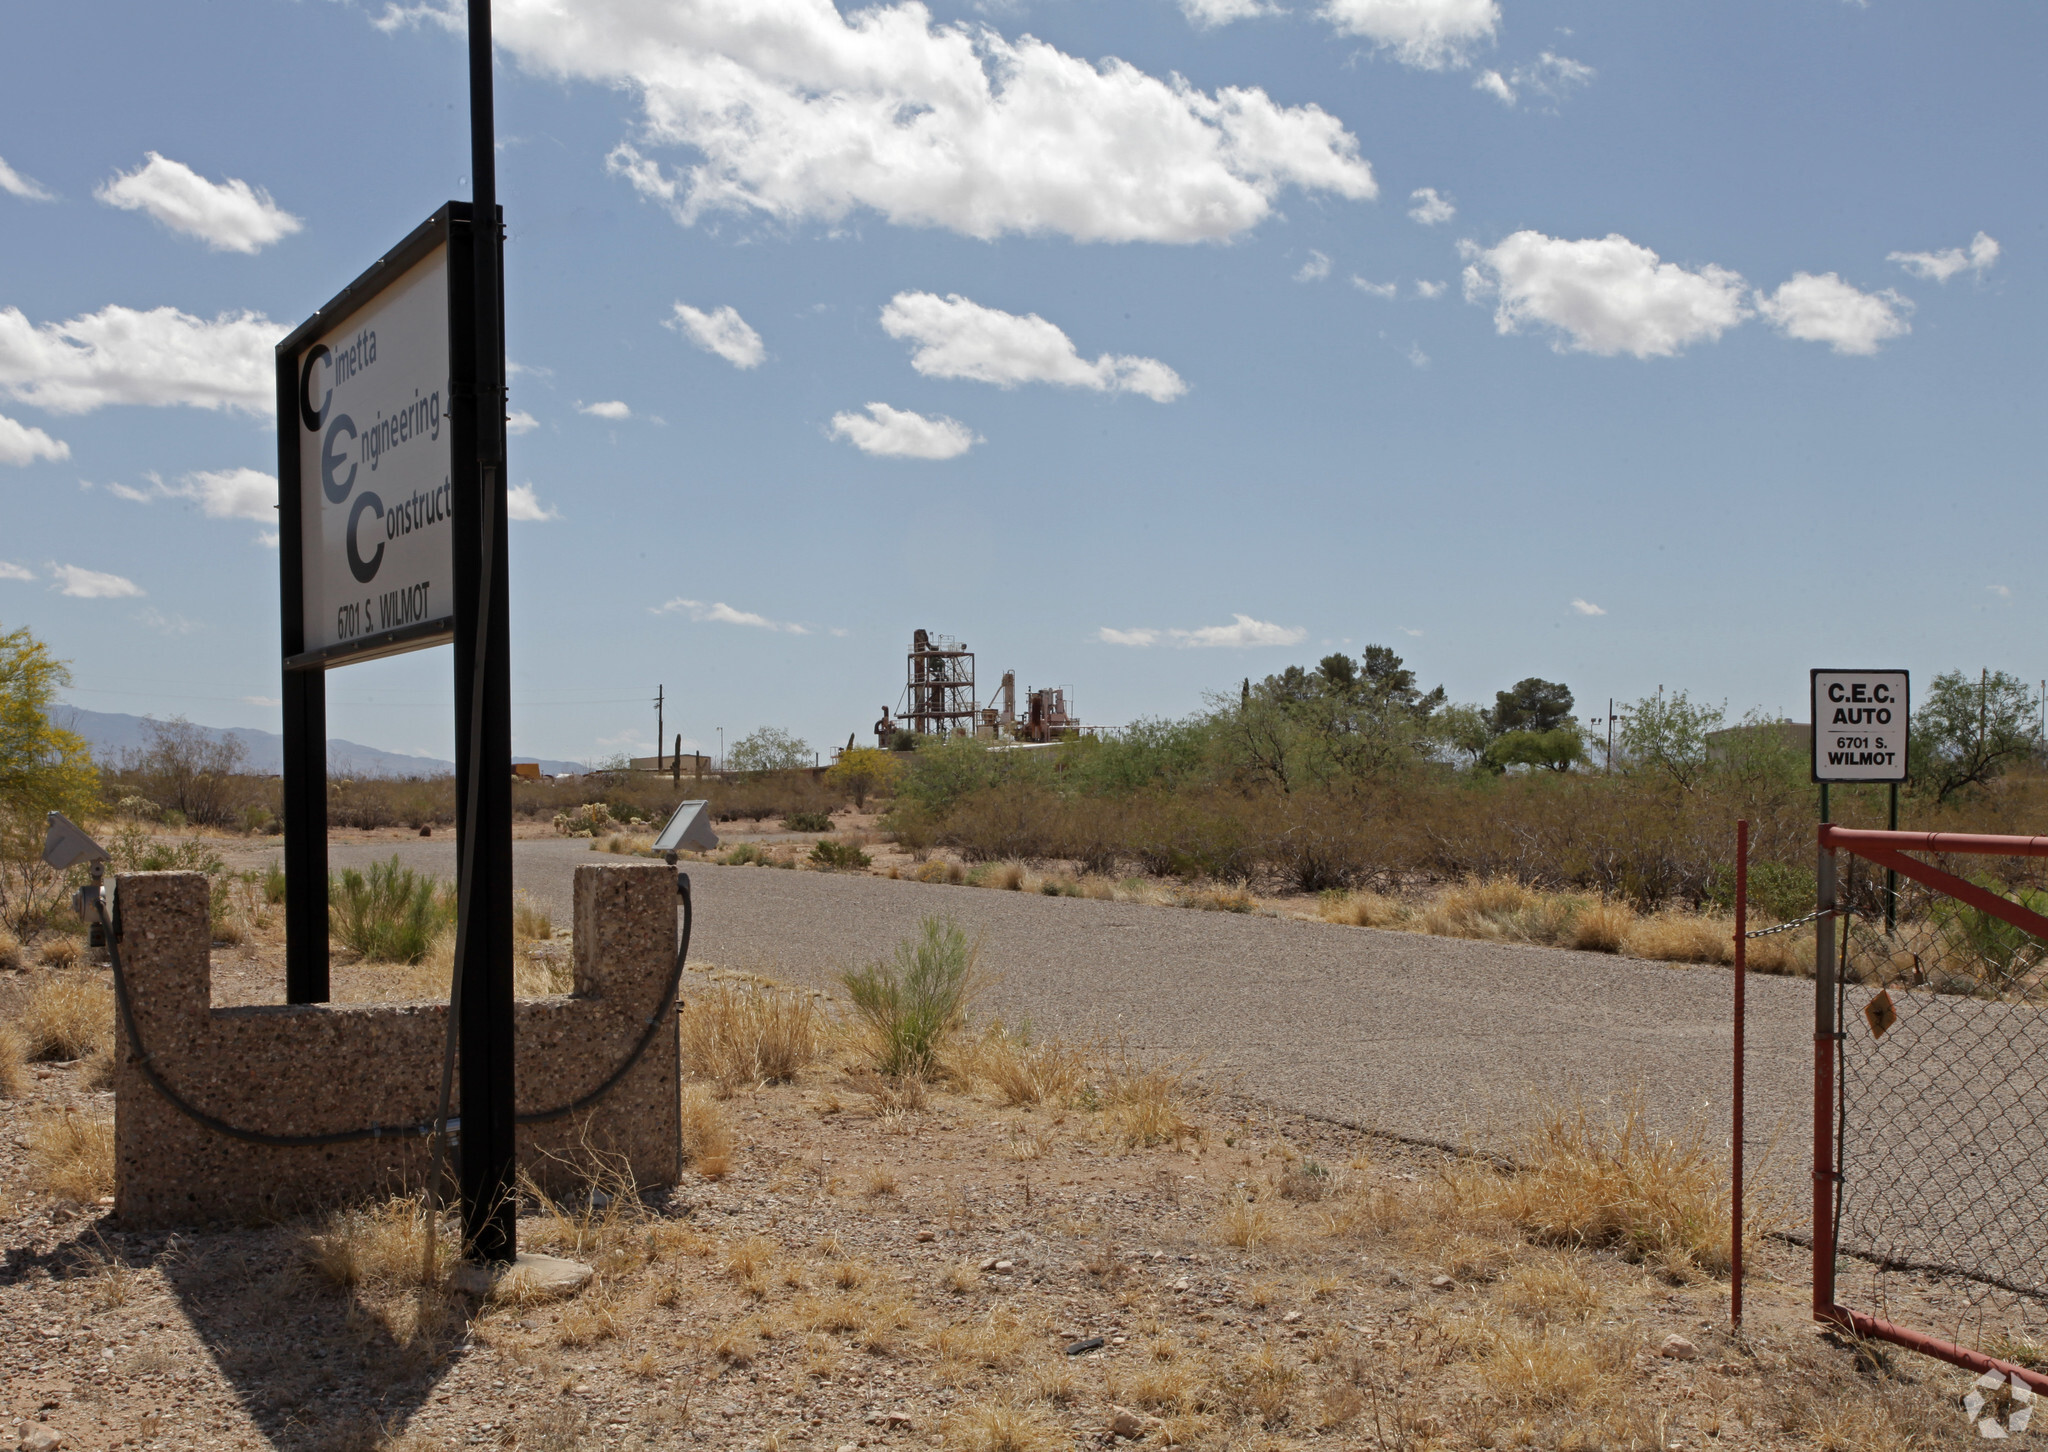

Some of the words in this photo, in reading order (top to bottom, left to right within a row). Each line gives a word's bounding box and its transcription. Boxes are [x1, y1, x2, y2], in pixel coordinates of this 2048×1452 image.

[300, 328, 377, 432] Cimetta
[321, 388, 440, 504] Engineering
[337, 602, 360, 640] 6701
[365, 598, 374, 633] S.
[379, 581, 430, 629] WILMOT
[1828, 683, 1895, 703] C.E.C.
[1832, 708, 1892, 724] AUTO
[1836, 737, 1868, 749] 6701
[1875, 737, 1888, 749] S.
[1828, 752, 1896, 765] WILMOT
